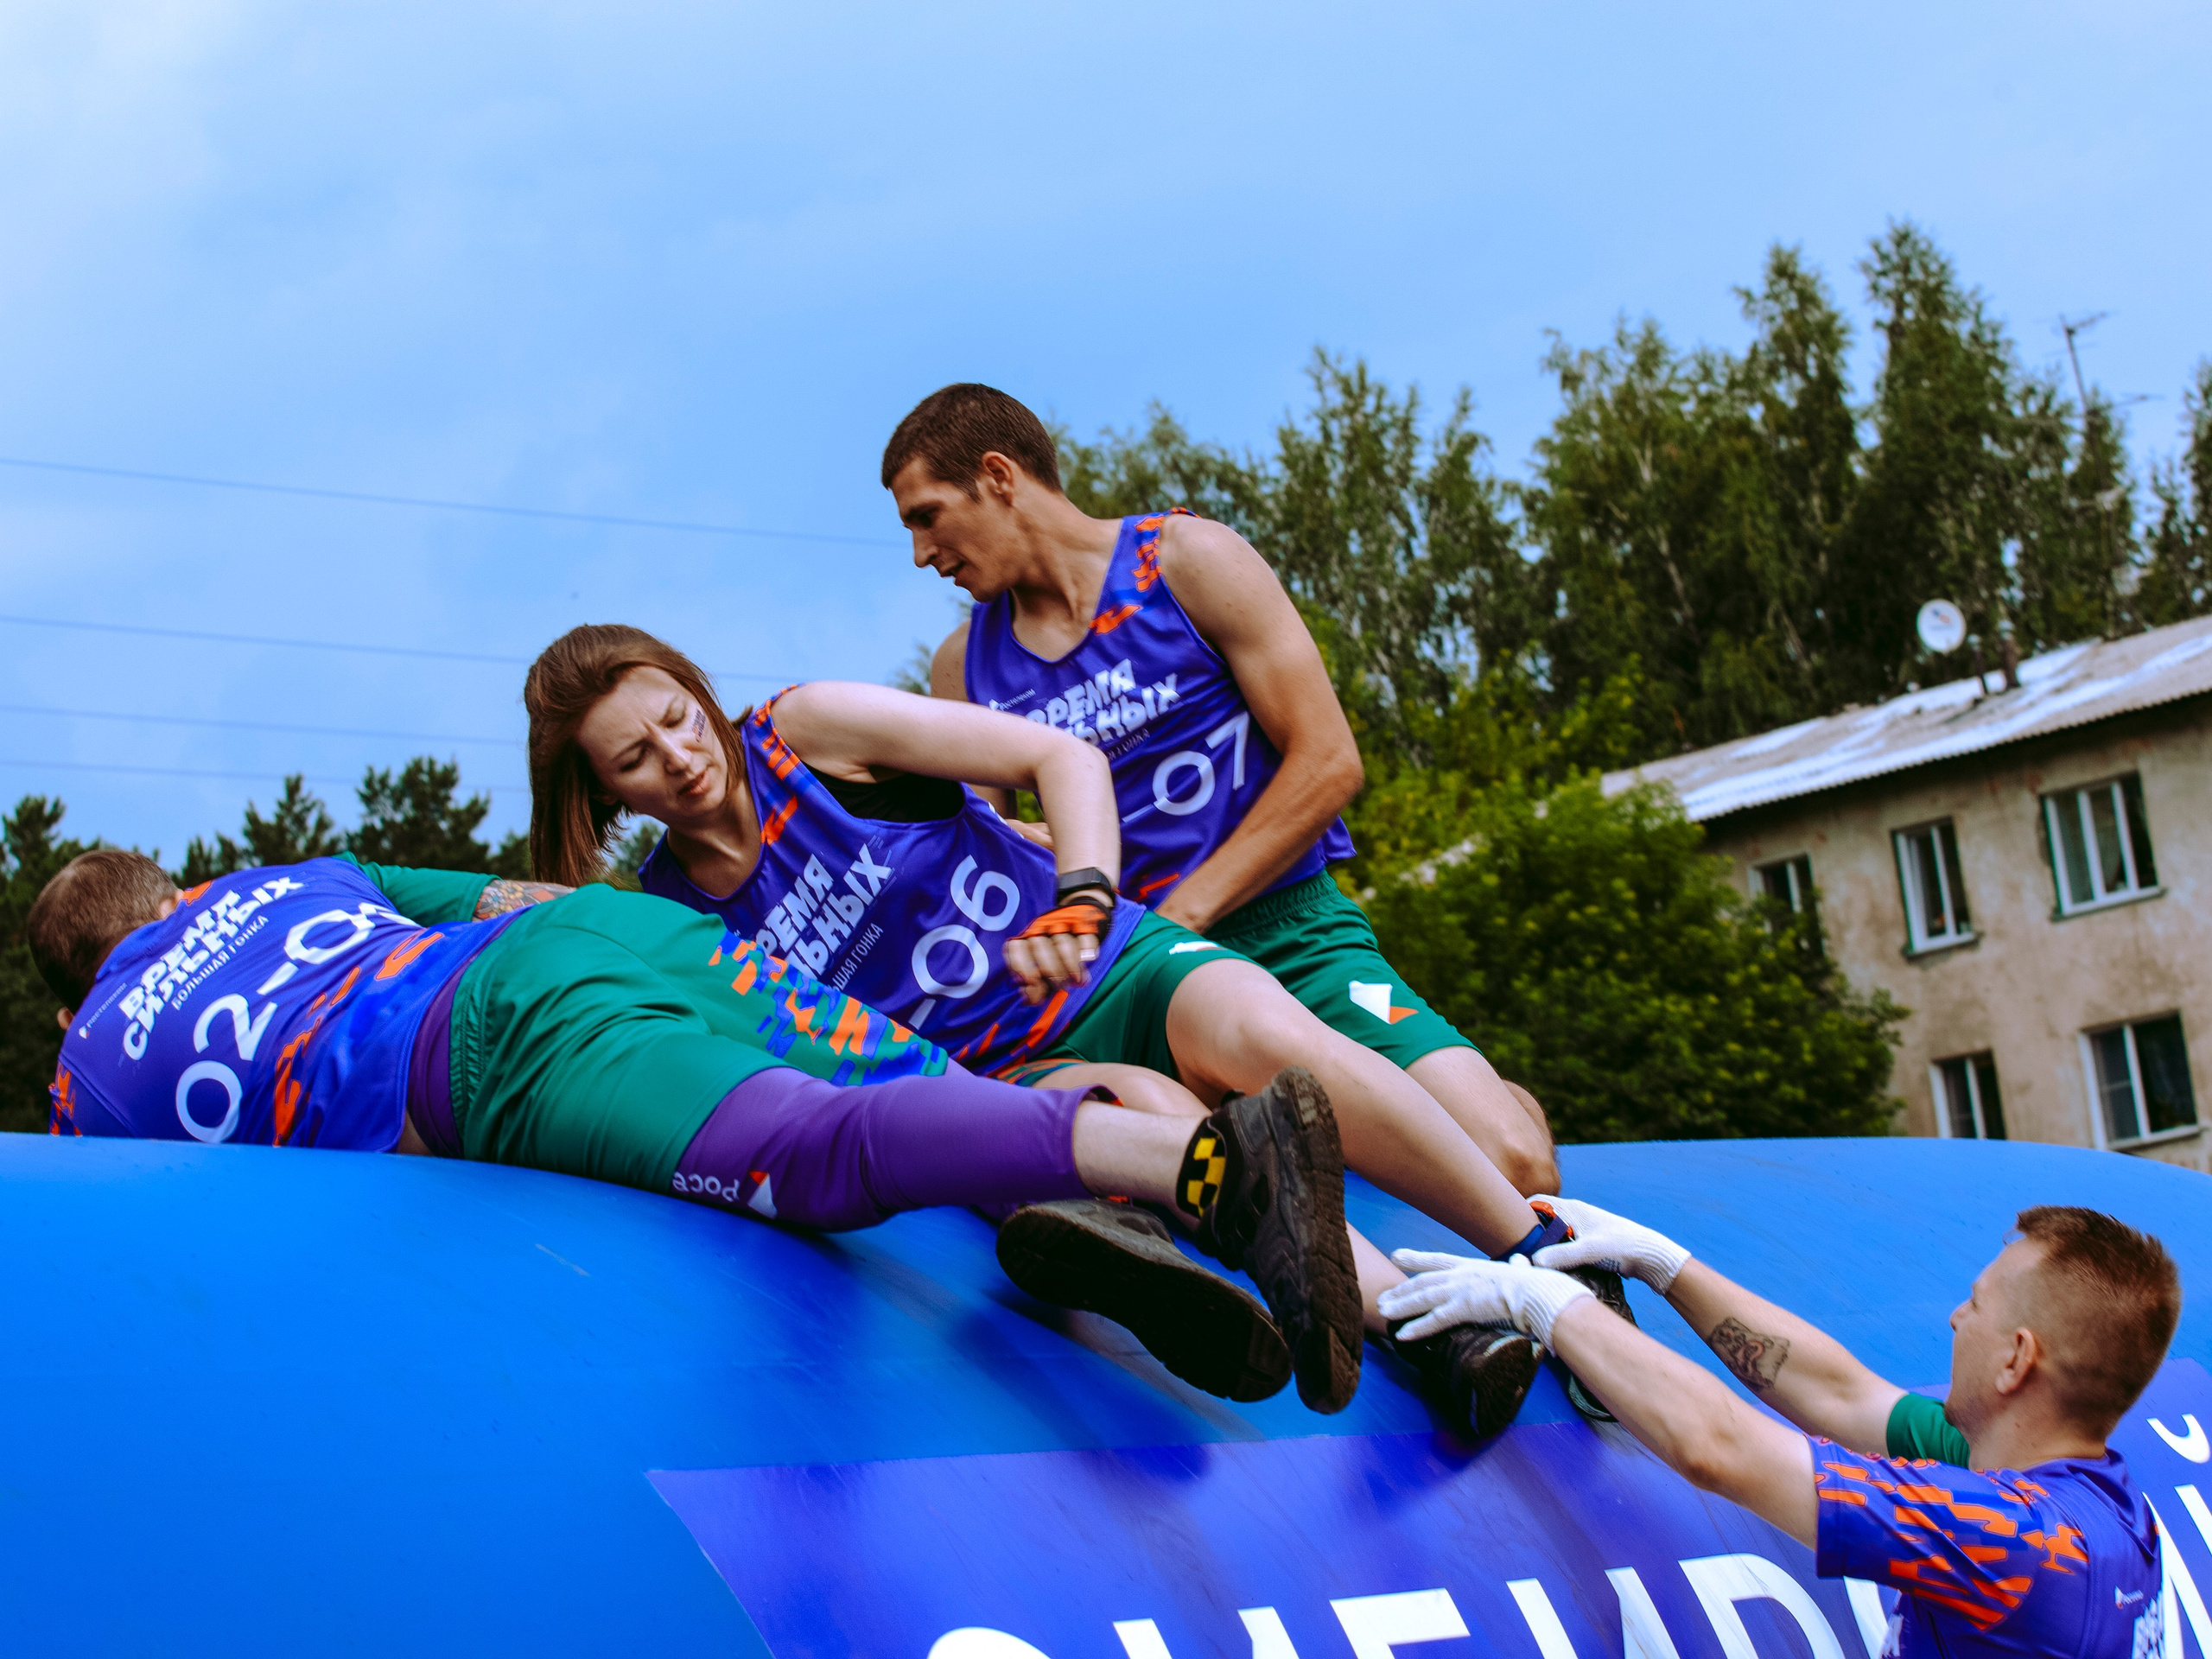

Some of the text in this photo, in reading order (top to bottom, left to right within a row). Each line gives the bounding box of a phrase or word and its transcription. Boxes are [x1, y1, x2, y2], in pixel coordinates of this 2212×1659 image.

[1064, 672, 1180, 746] ЬНЫХ
[1122, 710, 1249, 823] -07
[118, 889, 242, 1020] ВРЕМЯ
[755, 854, 833, 957] РЕМЯ
[785, 843, 892, 980] ЬНЫХ
[851, 922, 885, 964] ГОНКА
[908, 855, 1020, 1030] -06
[123, 876, 304, 1061] СИЛЬНЫХ
[171, 914, 270, 1011] БОЛЬШАЯ ГОНКА
